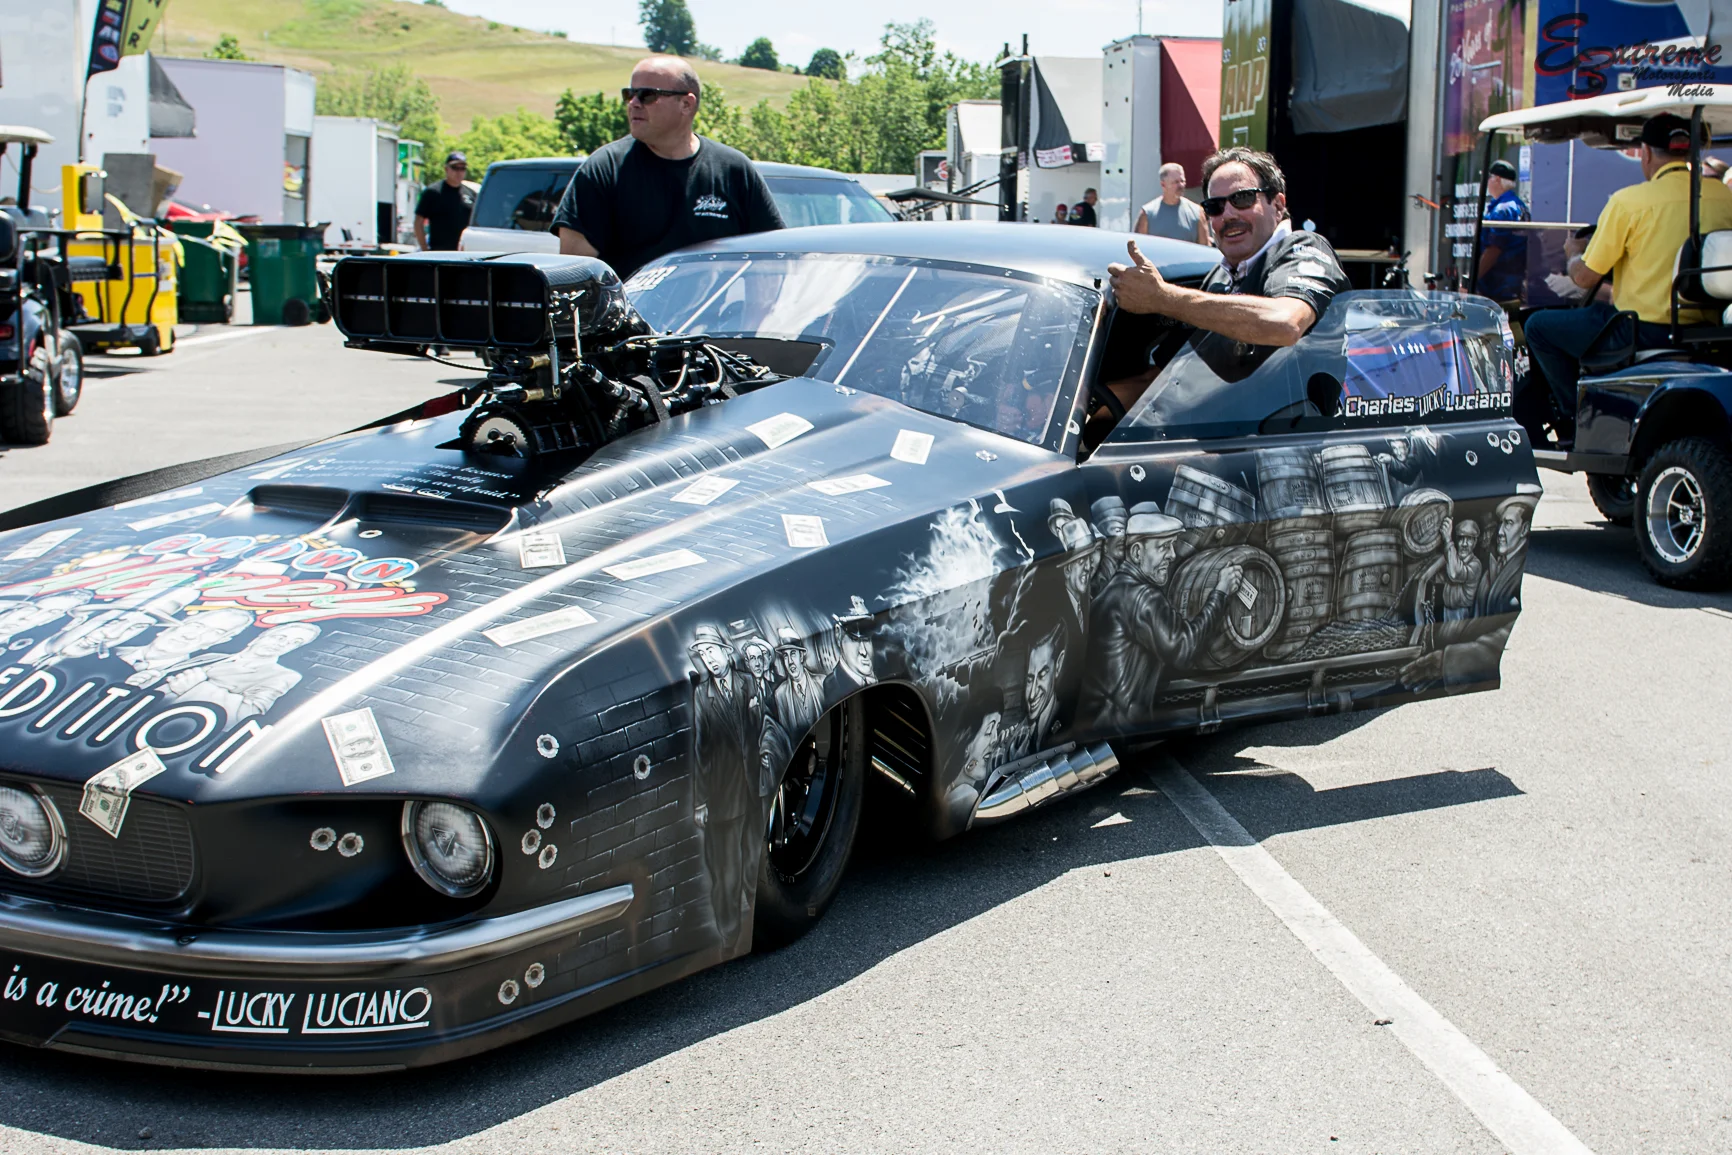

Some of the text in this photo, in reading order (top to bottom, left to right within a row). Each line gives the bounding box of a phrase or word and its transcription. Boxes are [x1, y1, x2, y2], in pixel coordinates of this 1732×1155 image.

[1345, 393, 1415, 417] Charles
[1445, 390, 1511, 412] Luciano
[3, 964, 28, 1001] is
[36, 981, 59, 1008] a
[301, 987, 433, 1034] LUCIANO
